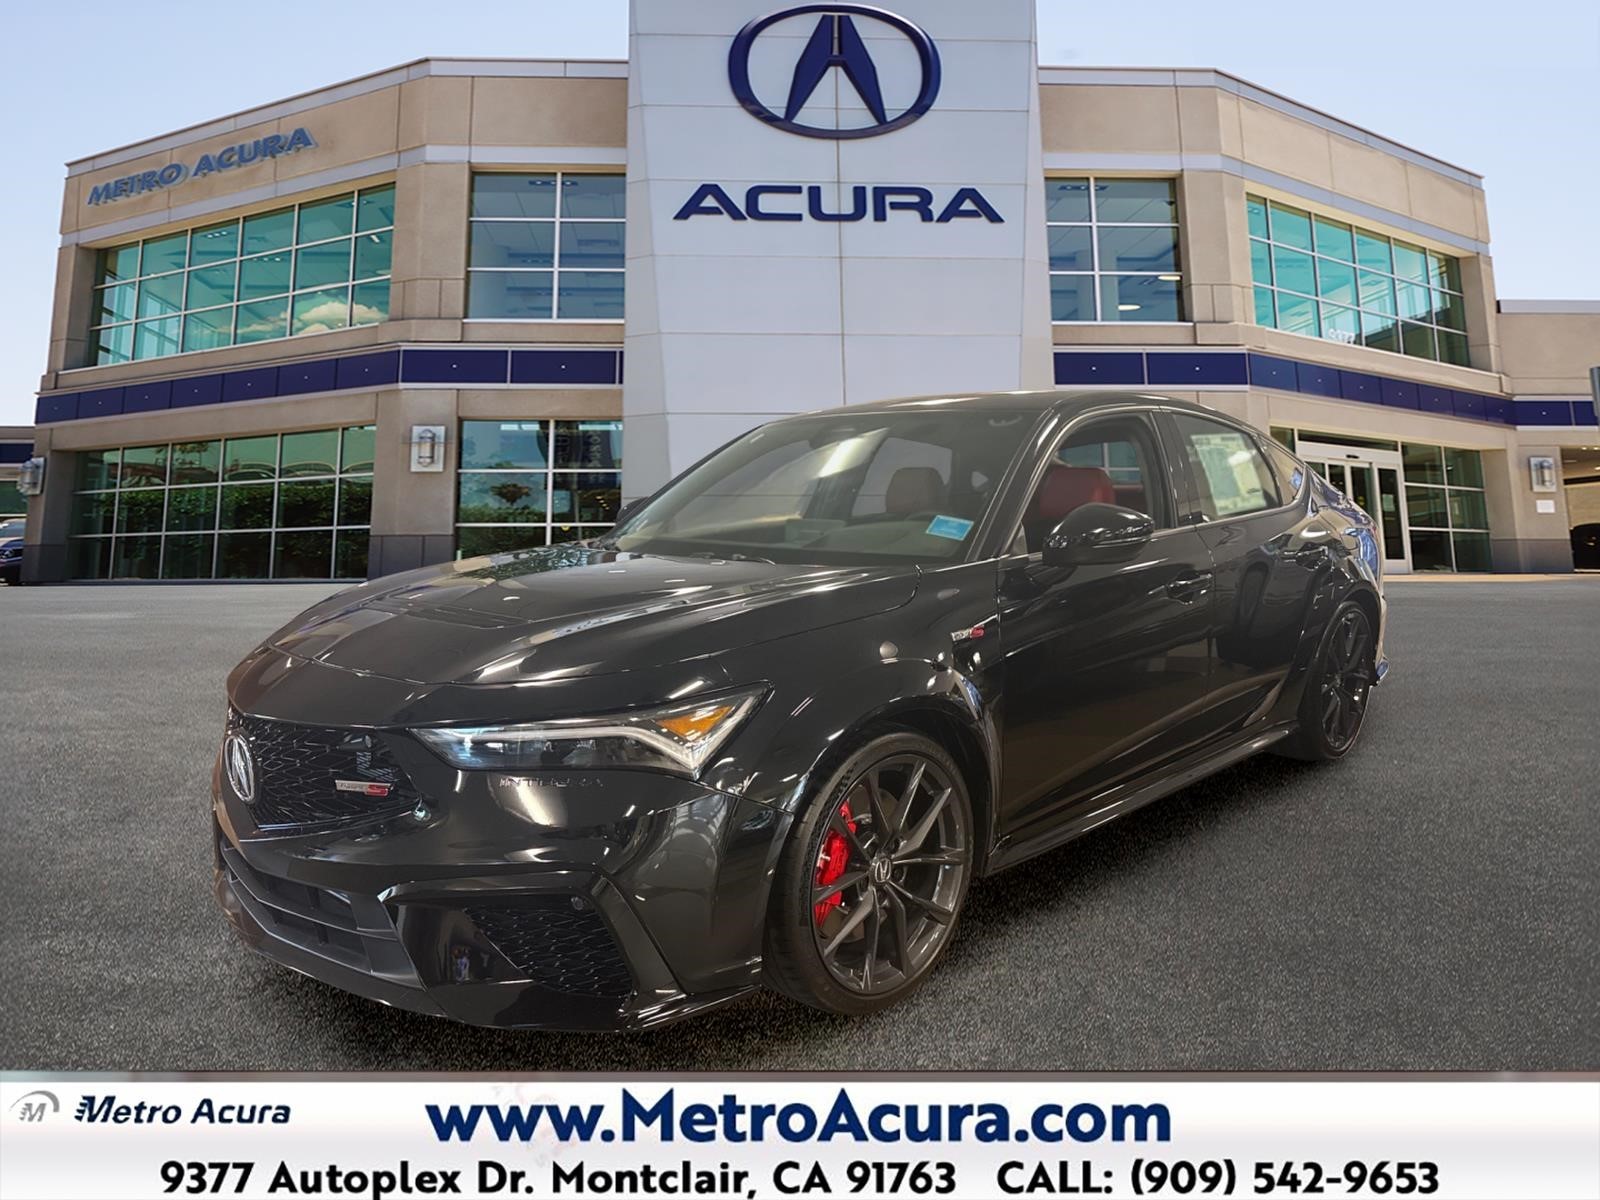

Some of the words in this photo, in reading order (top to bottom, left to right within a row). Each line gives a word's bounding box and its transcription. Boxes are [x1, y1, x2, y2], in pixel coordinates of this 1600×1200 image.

[88, 163, 183, 206] METRO
[192, 127, 314, 178] ACURA
[672, 183, 1005, 223] ACURA
